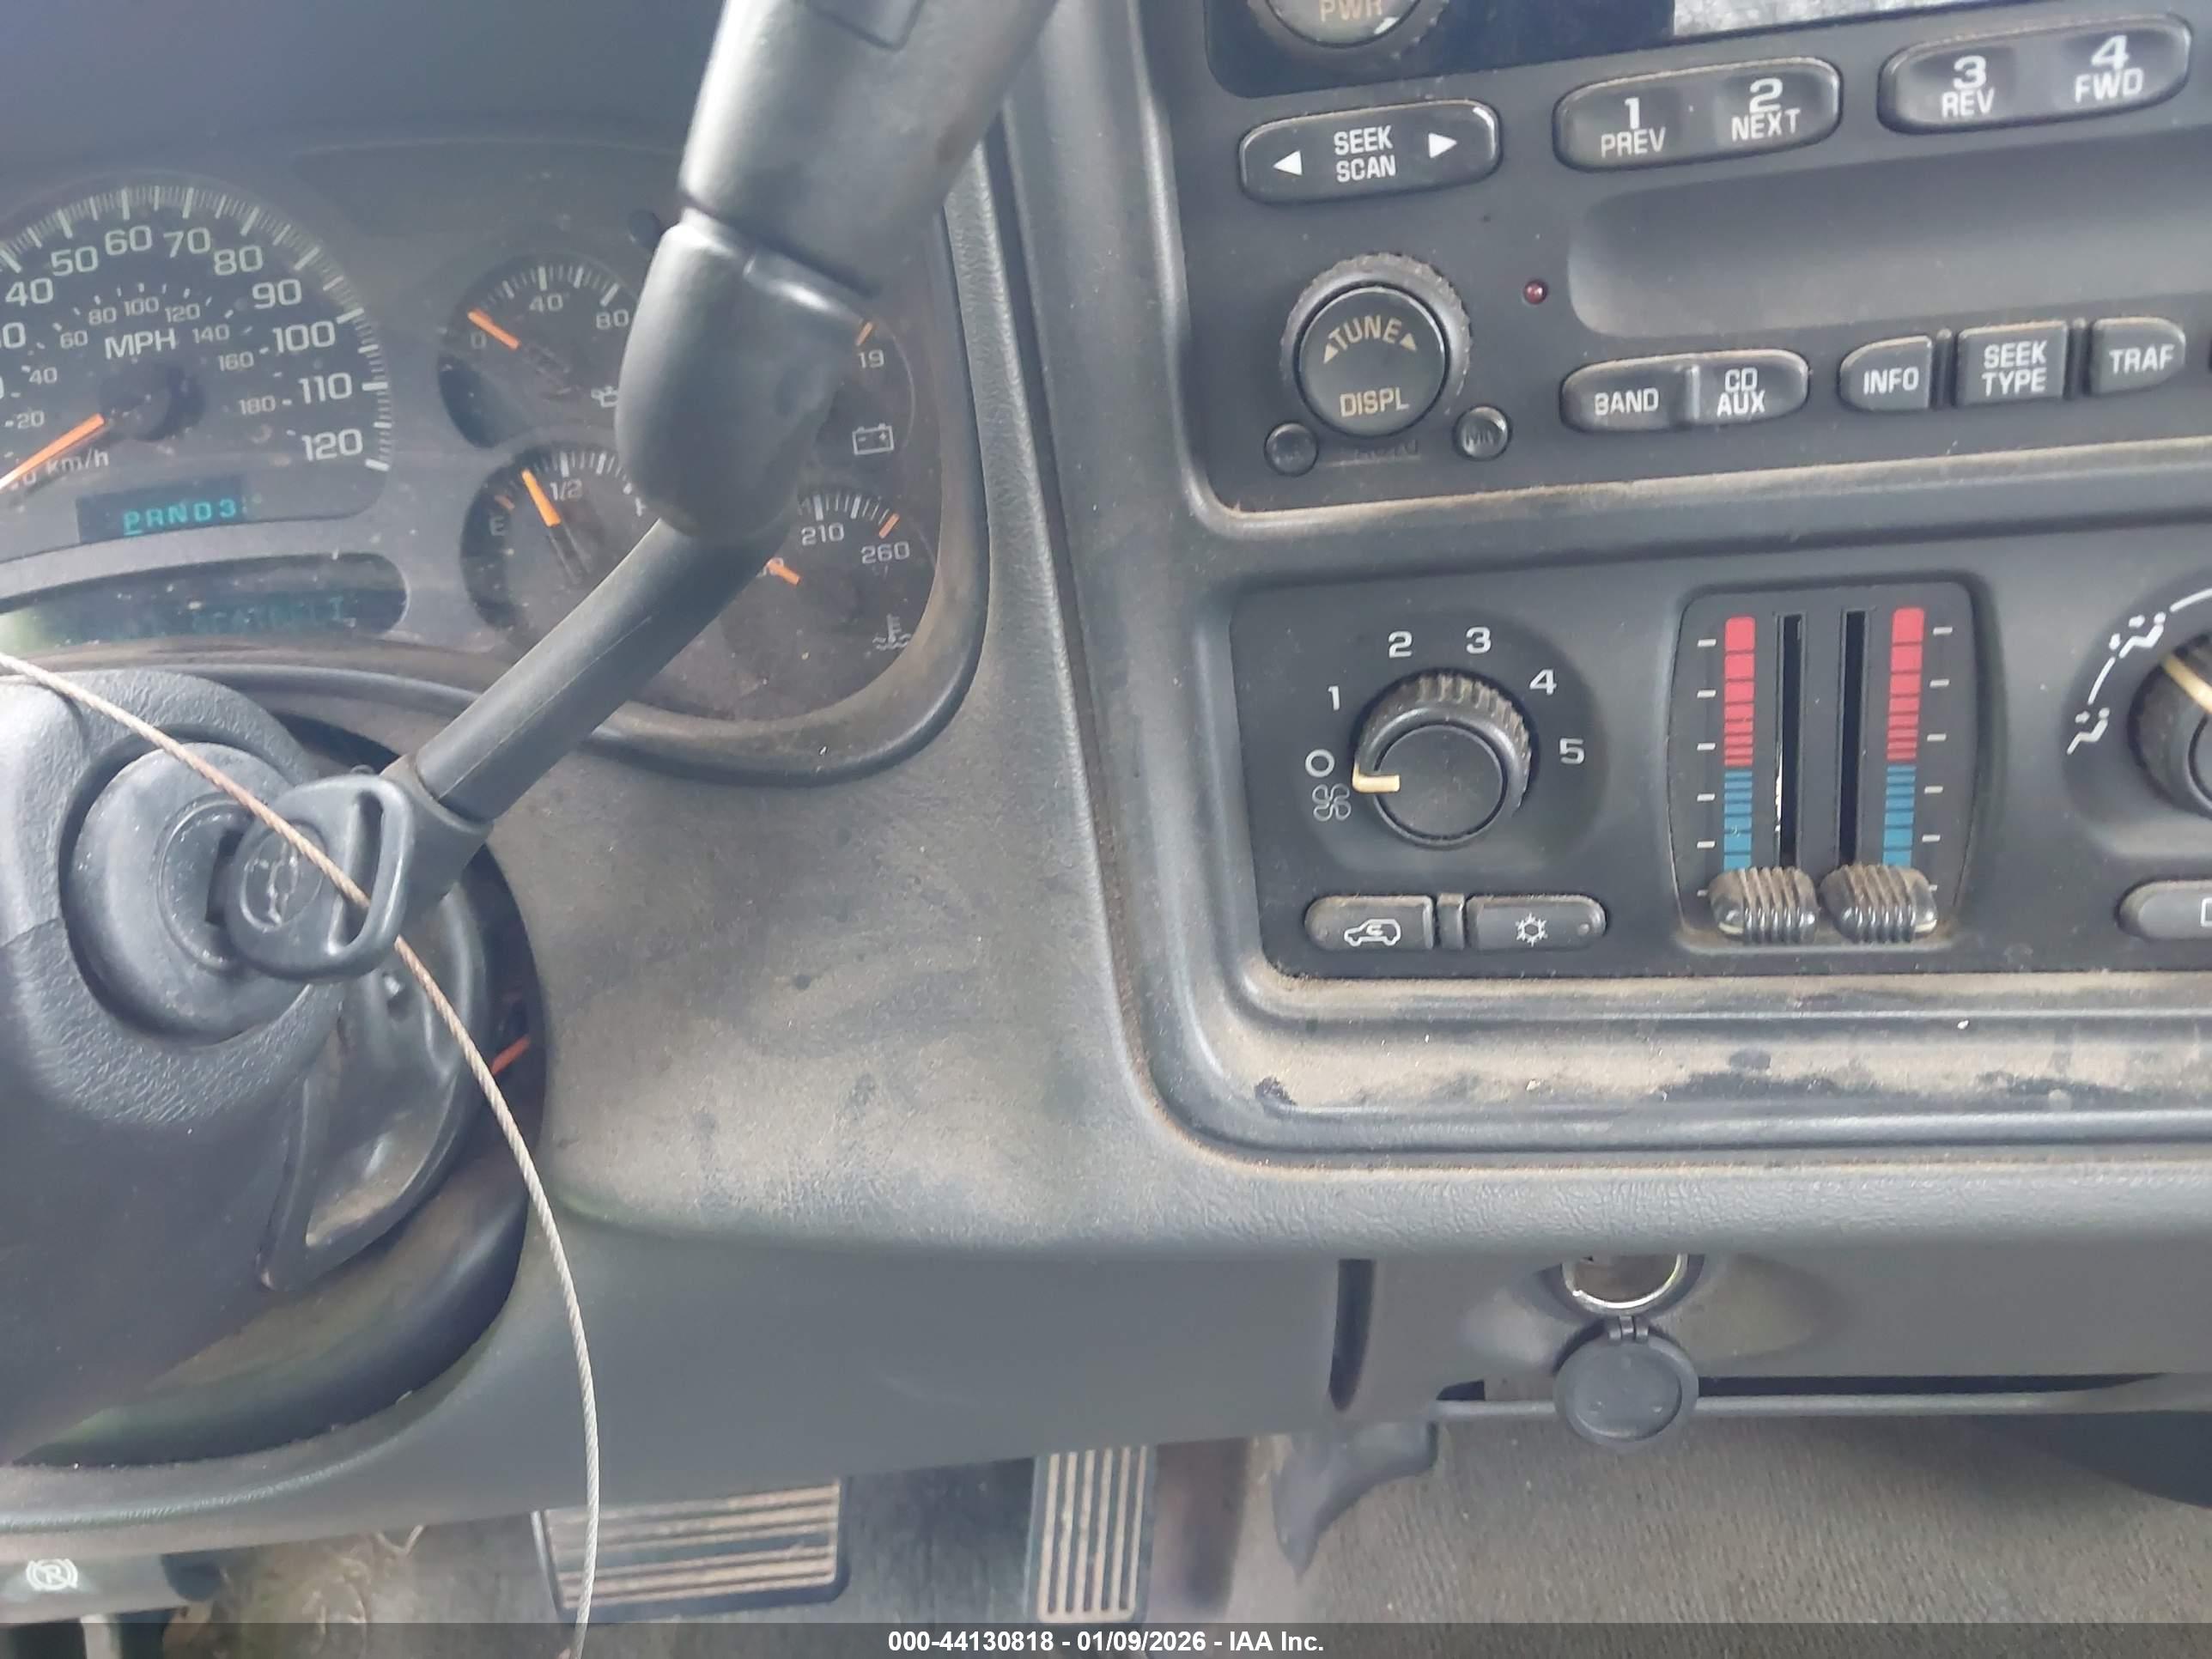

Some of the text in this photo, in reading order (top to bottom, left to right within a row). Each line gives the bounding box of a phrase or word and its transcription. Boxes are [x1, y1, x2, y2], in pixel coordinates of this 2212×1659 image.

[2091, 34, 2129, 70] 4
[1954, 55, 1987, 90] 3
[2075, 68, 2143, 103] FWD
[1749, 77, 1783, 112] 2
[1942, 88, 1995, 118] REV
[1624, 97, 1640, 130] 1
[1731, 109, 1801, 141] NEXT
[1334, 125, 1393, 156] SEEK
[1600, 127, 1666, 158] PREV
[1336, 155, 1396, 183] SCAN
[104, 225, 153, 256] 60
[163, 227, 211, 258] 70
[51, 246, 98, 276] 50
[214, 245, 264, 276] 80
[4, 277, 53, 307] 40
[252, 279, 302, 310] 90
[529, 295, 563, 313] 40
[88, 307, 117, 326] 80
[124, 296, 160, 318] 100
[164, 303, 201, 323] 120
[596, 309, 629, 330] 80
[60, 331, 88, 349] 60
[104, 328, 176, 360] MPH
[192, 324, 230, 343] 140
[272, 320, 336, 354] 100
[1328, 314, 1402, 351] TUNE
[218, 351, 254, 371] 160
[858, 349, 885, 368] 19
[1983, 340, 2047, 370] SEEK
[2109, 344, 2174, 374] TRAF
[28, 367, 58, 385] 40
[298, 373, 352, 404] 110
[1724, 368, 1758, 392] CD
[1863, 367, 1919, 394] INFO
[1982, 368, 2046, 396] TYPE
[238, 395, 276, 416] 180
[1340, 387, 1410, 418] DISPL
[1594, 388, 1660, 416] BAND
[1717, 391, 1765, 417] AUX
[15, 410, 45, 428] 20
[301, 428, 363, 463] 120
[46, 449, 109, 477] km/h
[550, 478, 583, 501] 1/2
[489, 516, 505, 537] E
[801, 523, 845, 545] 210
[860, 541, 910, 564] 260
[1388, 630, 1413, 659] 2
[1466, 627, 1492, 654] 3
[1529, 668, 1557, 695] 4
[1327, 685, 1340, 711] 1
[1559, 738, 1585, 764] 5
